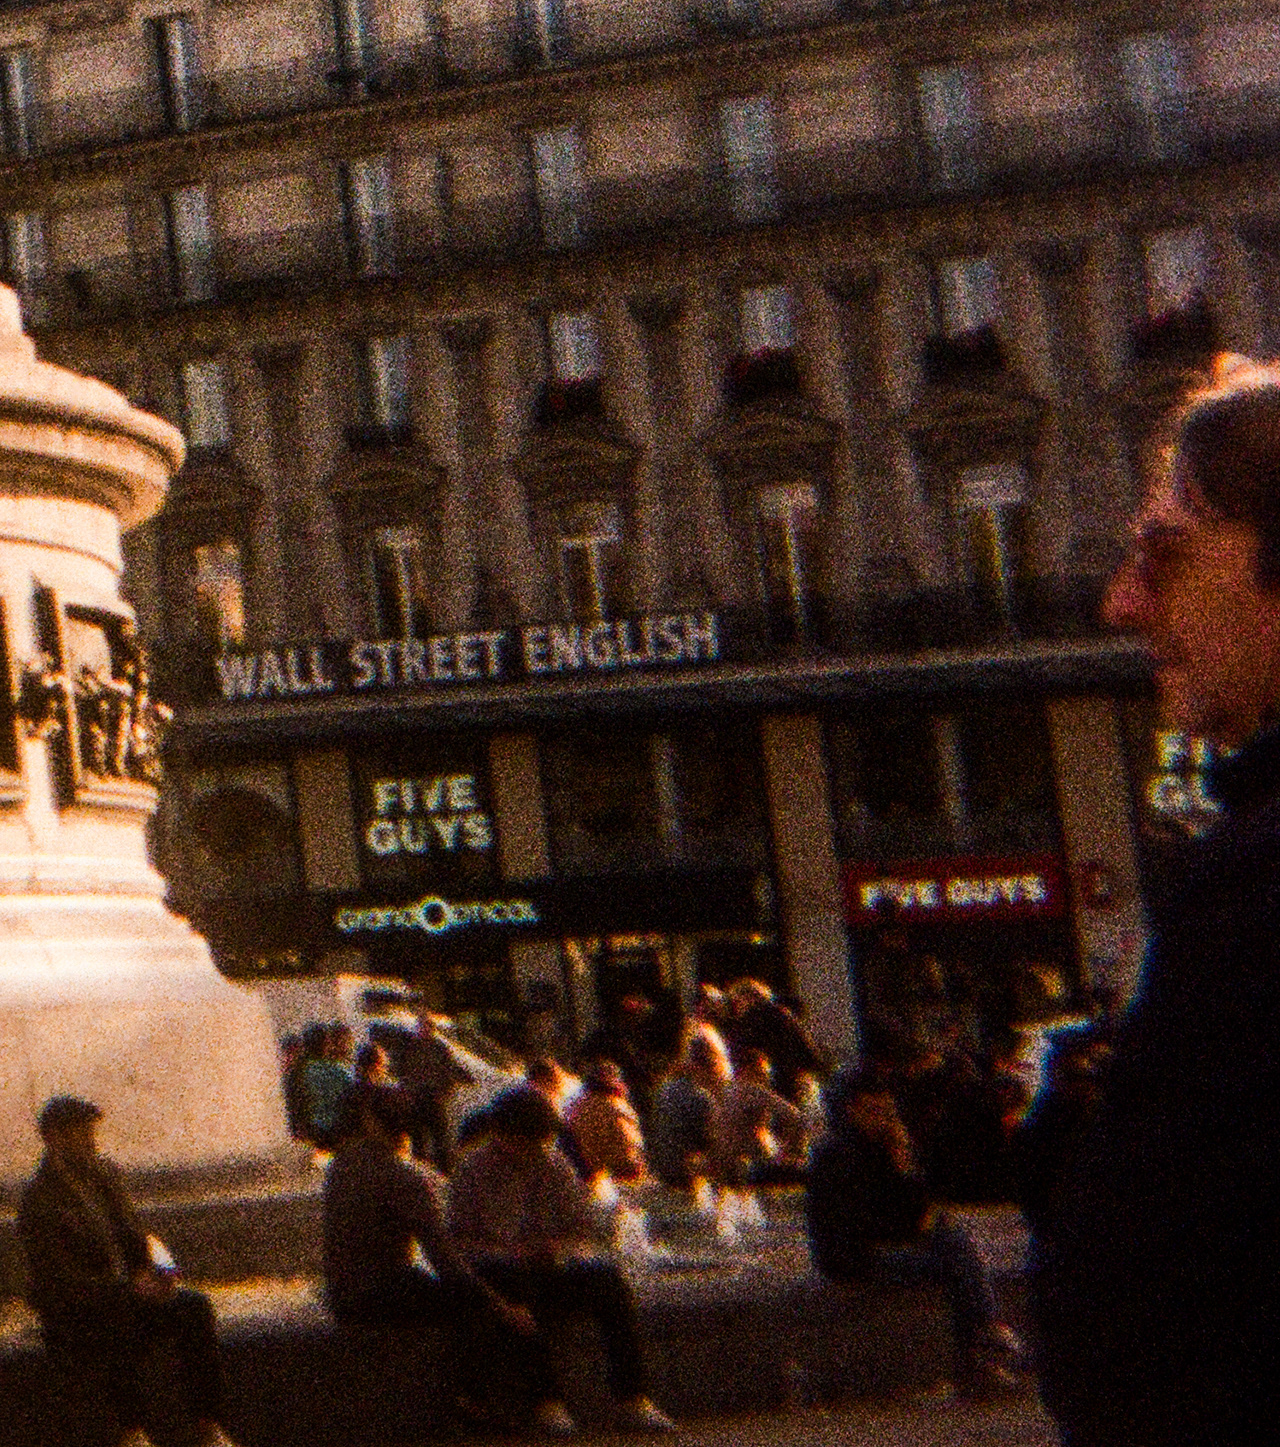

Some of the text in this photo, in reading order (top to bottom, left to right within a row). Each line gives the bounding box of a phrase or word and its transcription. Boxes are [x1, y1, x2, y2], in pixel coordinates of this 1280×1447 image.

[217, 613, 721, 701] WALL STREET ENGLISH
[373, 773, 478, 815] FIVE
[365, 813, 494, 855] GUYS
[860, 873, 1048, 910] FIVE GUYS
